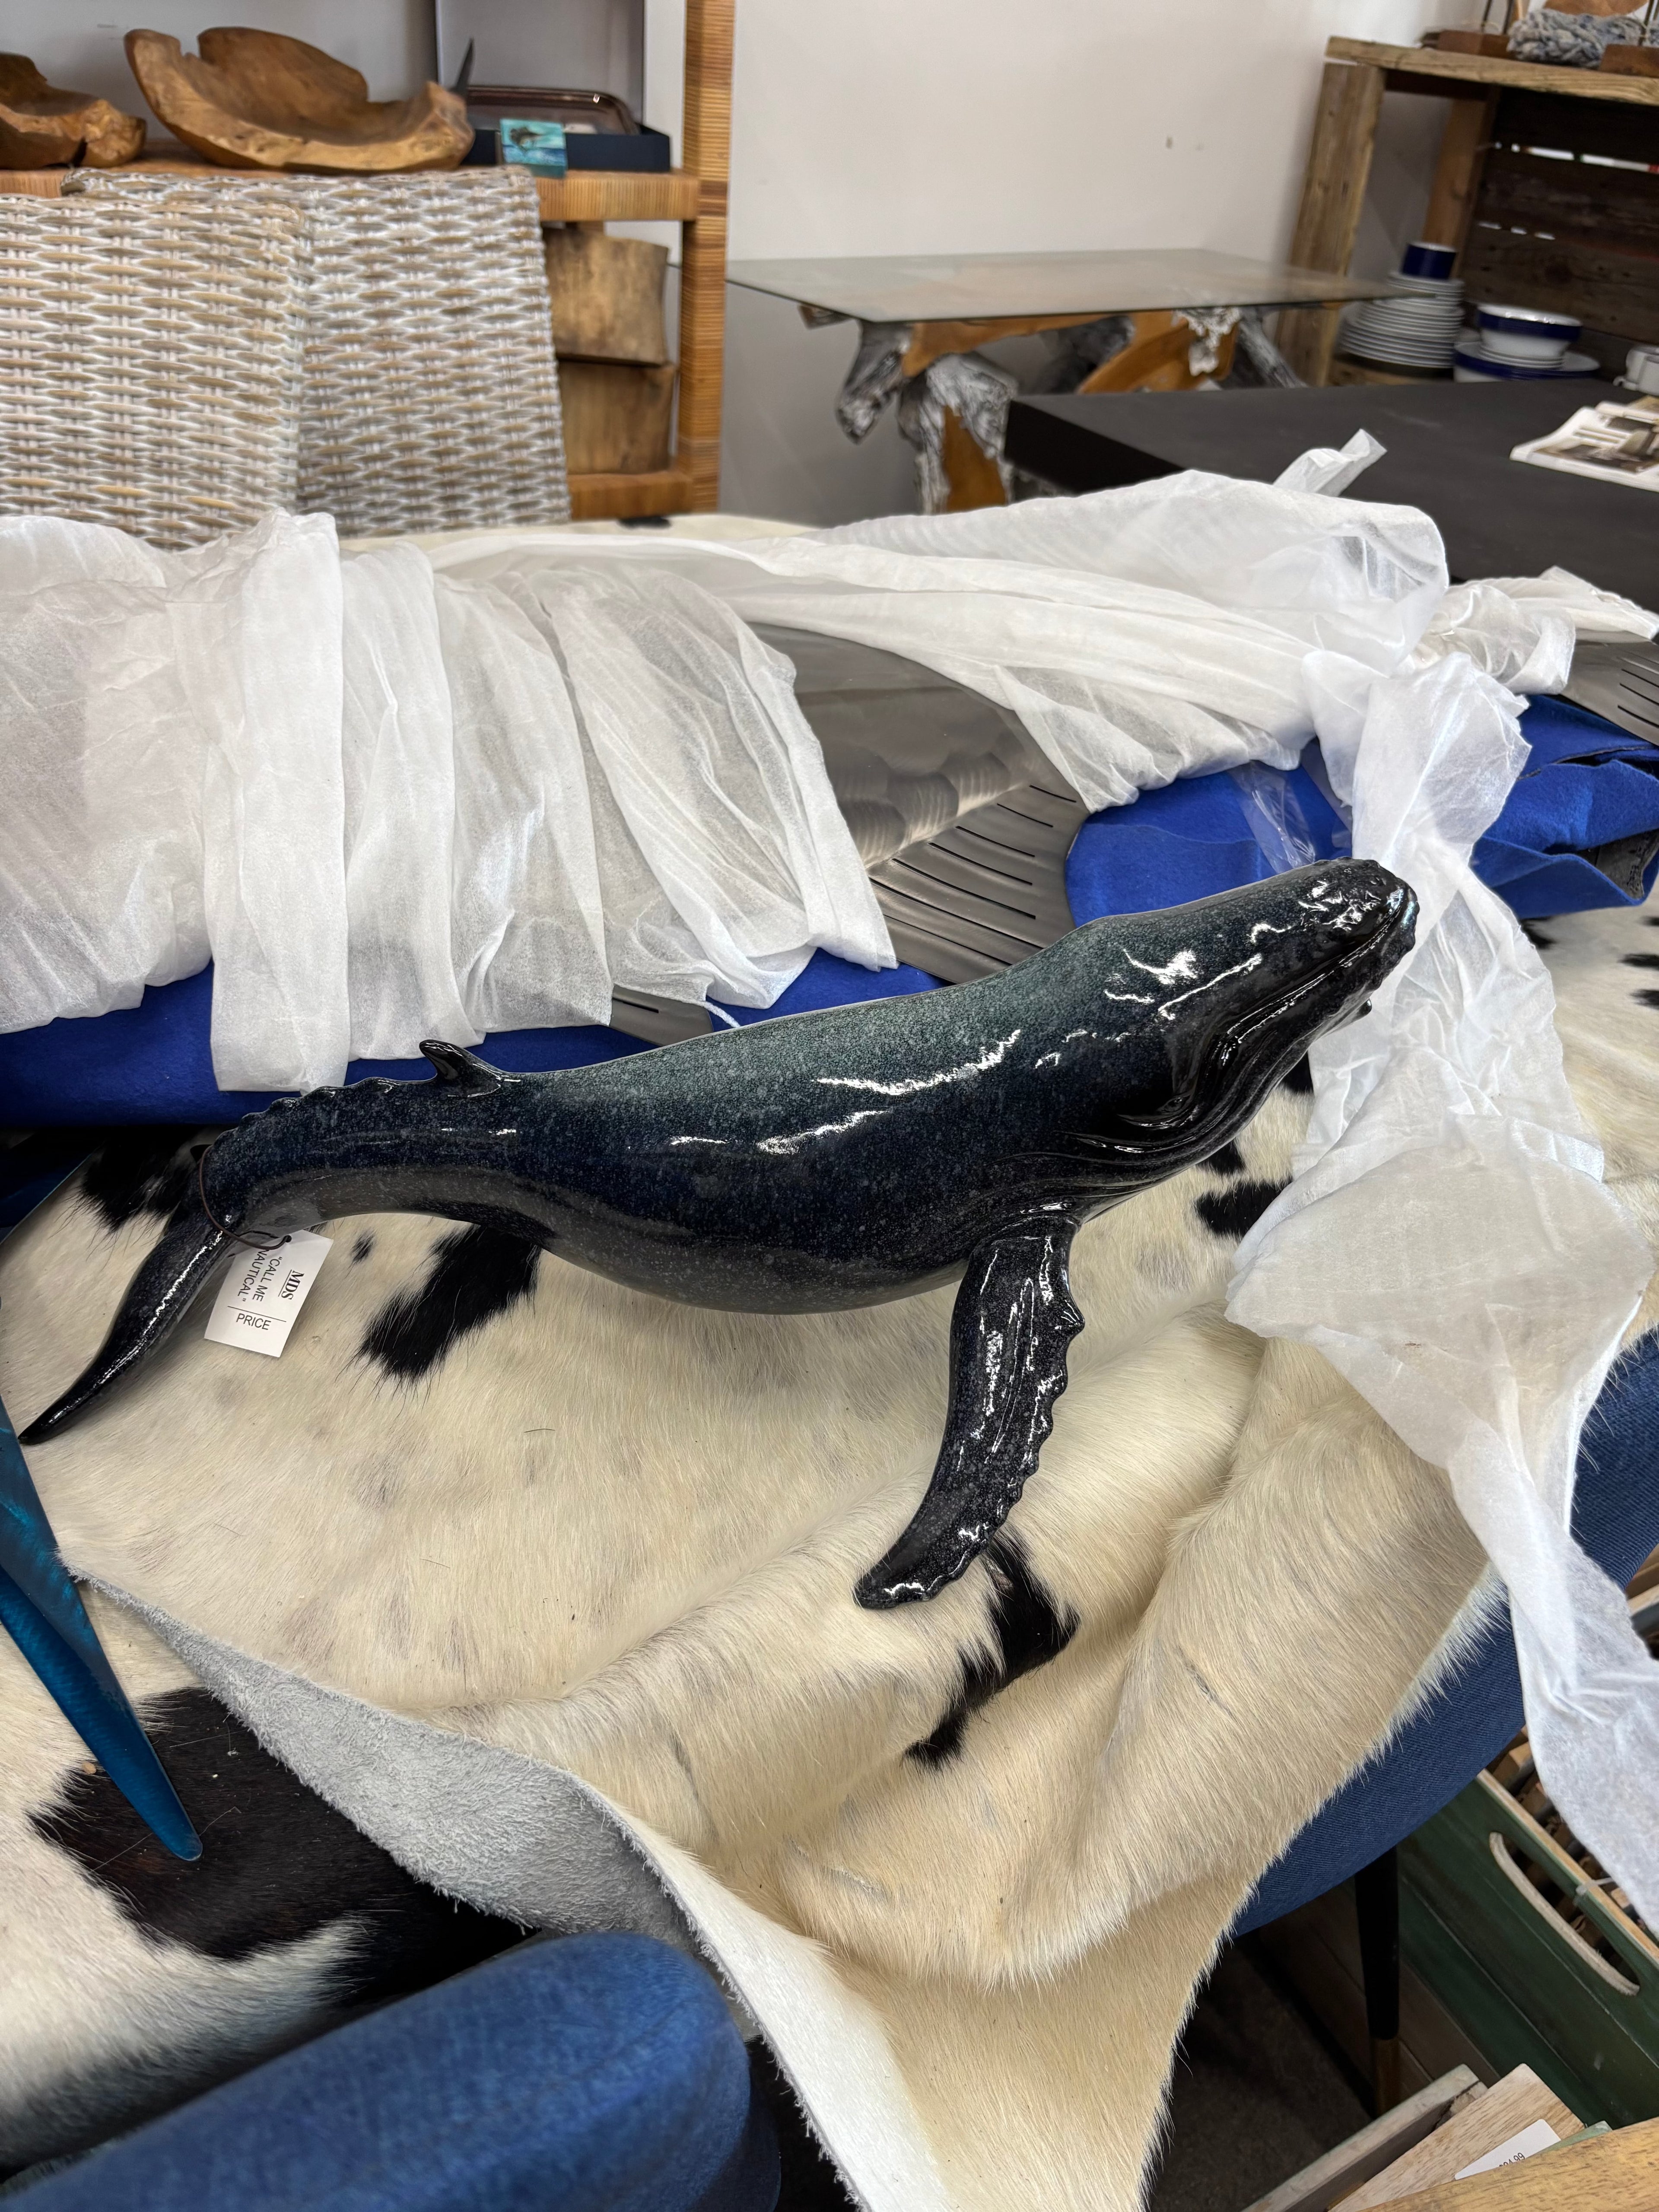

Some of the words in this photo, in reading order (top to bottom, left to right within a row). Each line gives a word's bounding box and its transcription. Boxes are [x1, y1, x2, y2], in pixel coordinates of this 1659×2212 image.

[252, 1285, 268, 1302] ME
[281, 1270, 305, 1300] MDS
[236, 1313, 272, 1330] PRICE
